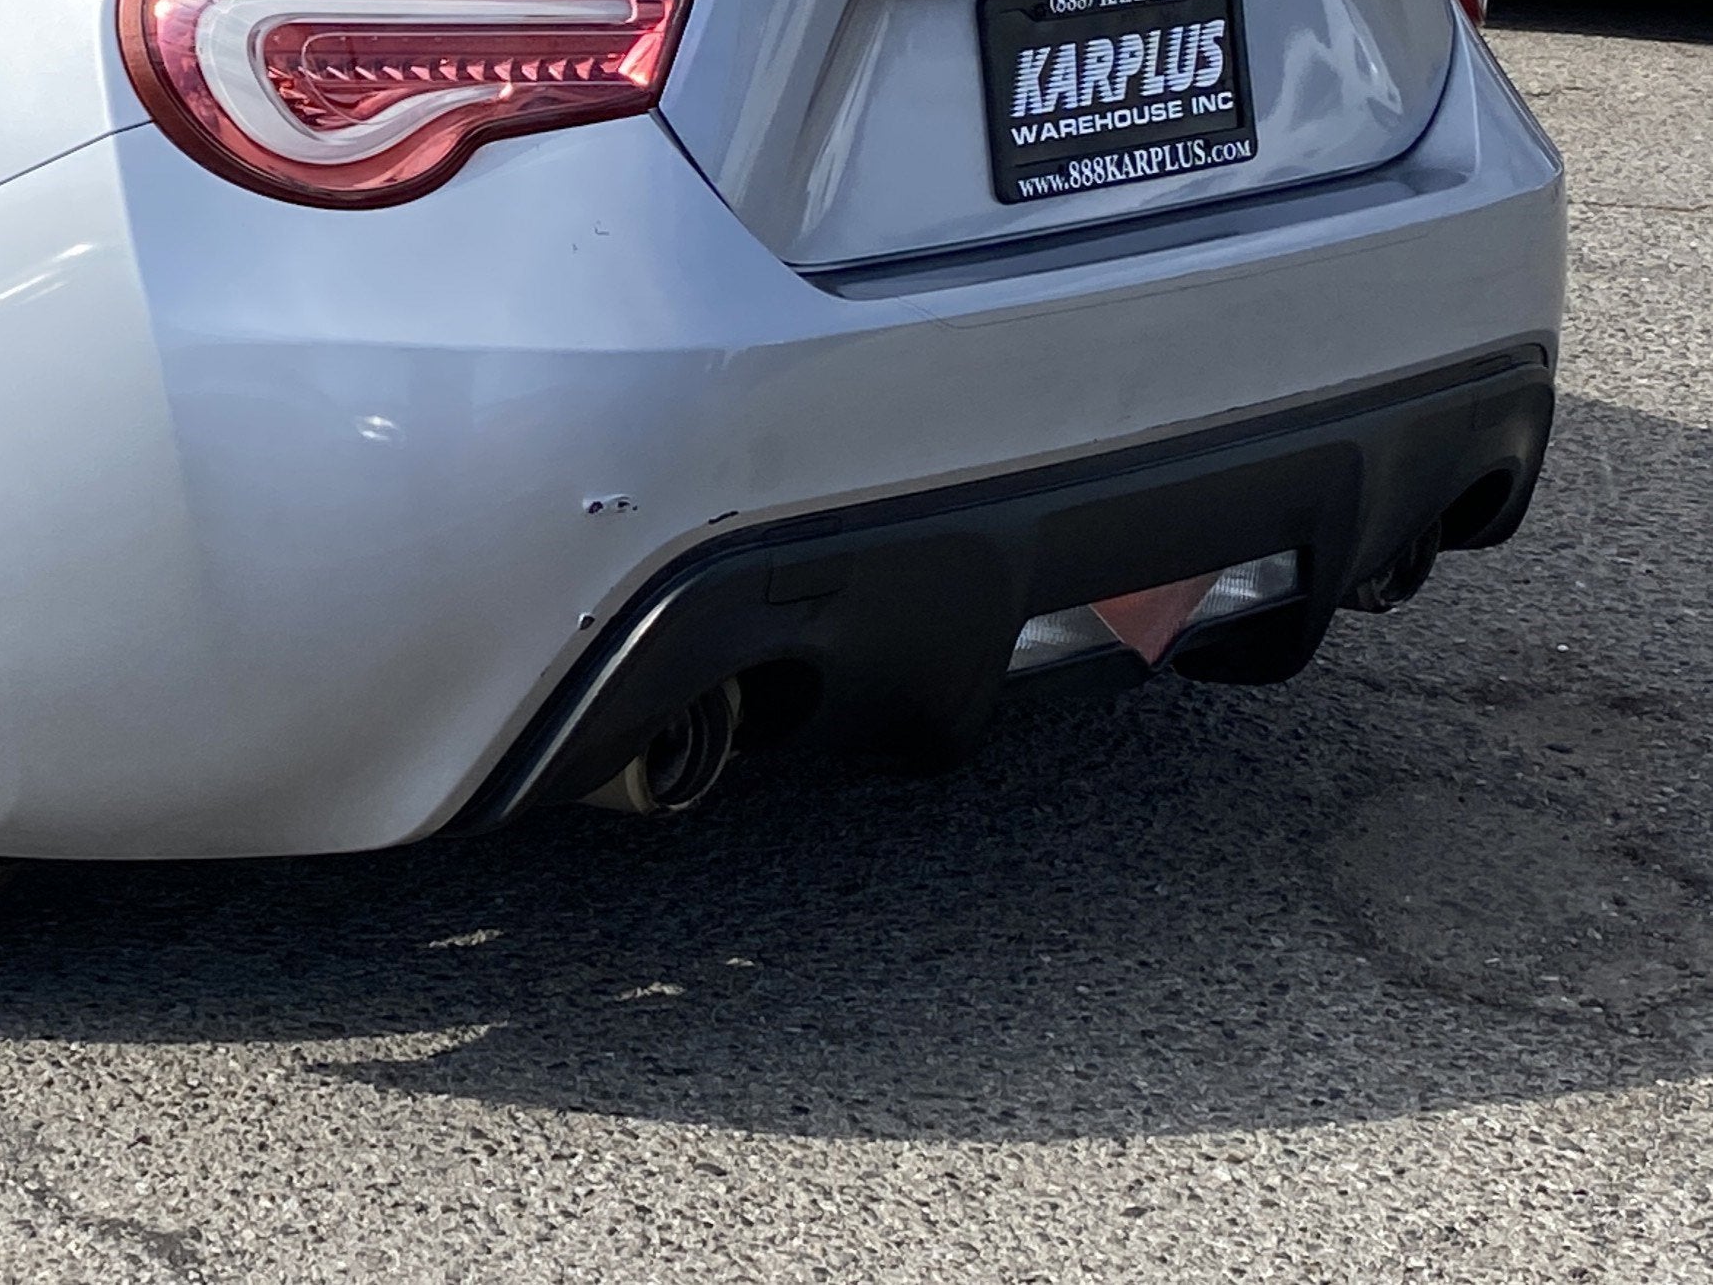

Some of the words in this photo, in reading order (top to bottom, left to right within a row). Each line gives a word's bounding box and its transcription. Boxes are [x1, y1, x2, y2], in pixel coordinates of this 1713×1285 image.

[1010, 19, 1225, 117] KARPLUS
[1011, 100, 1184, 145] WAREHOUSE
[1191, 92, 1234, 115] INC
